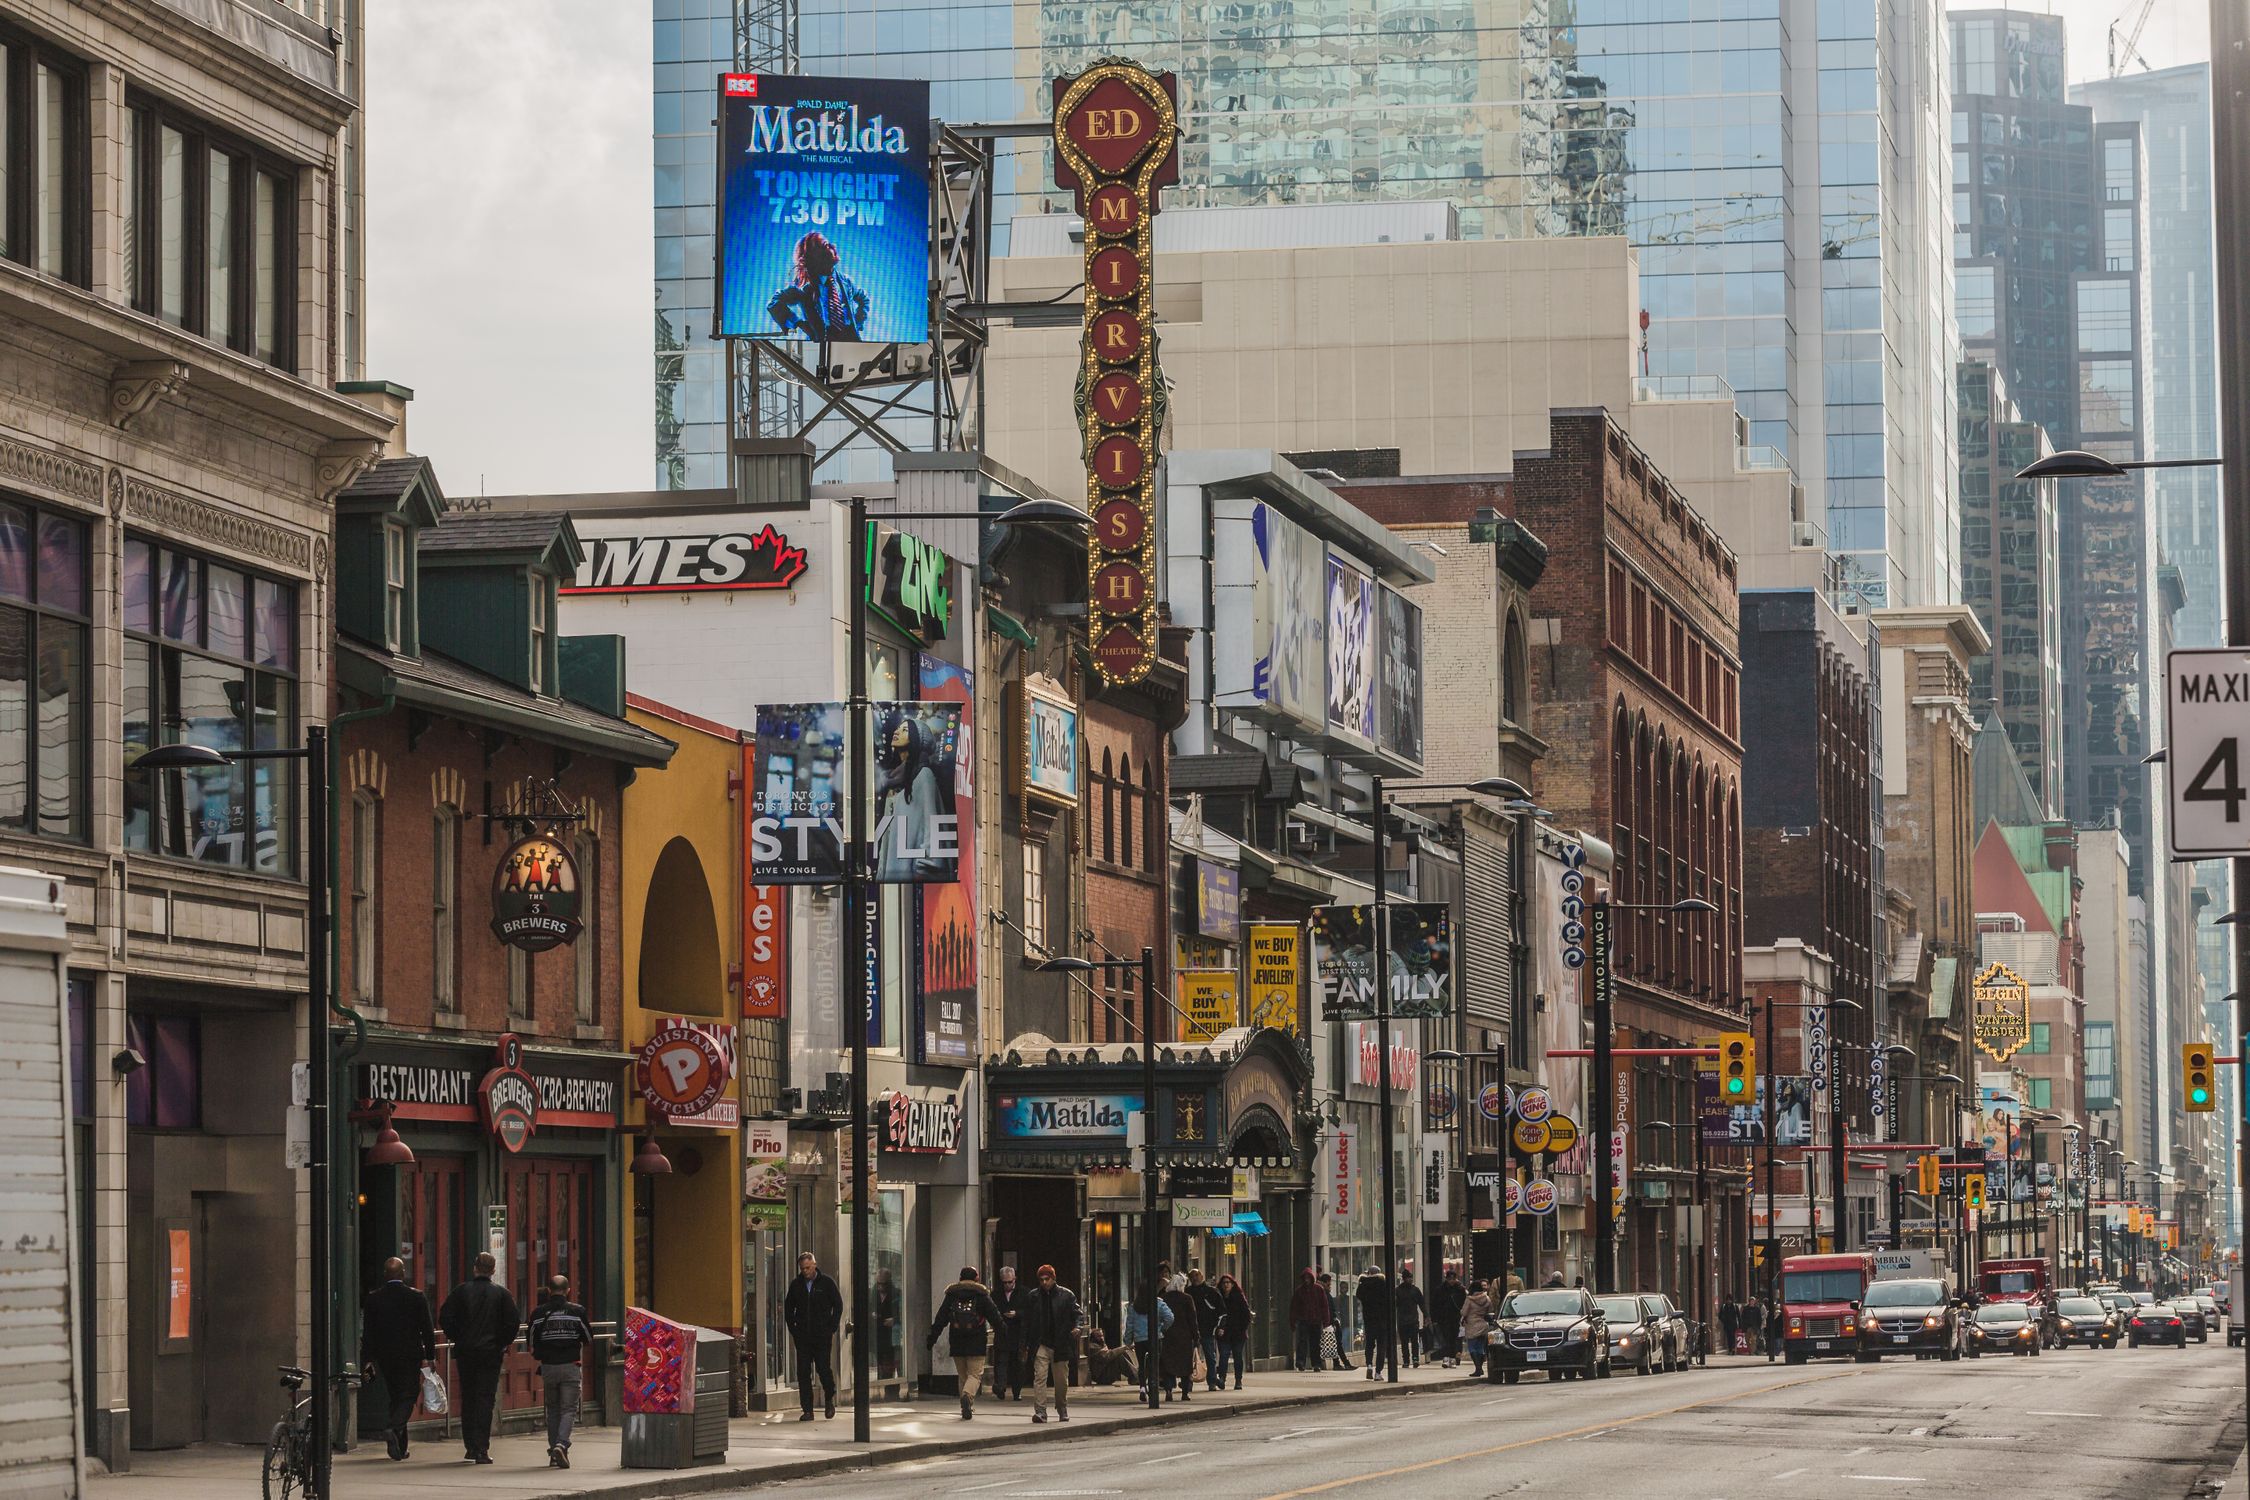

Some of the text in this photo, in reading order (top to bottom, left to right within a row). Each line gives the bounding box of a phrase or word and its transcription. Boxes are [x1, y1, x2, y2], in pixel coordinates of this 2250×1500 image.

[727, 78, 755, 93] RSC
[797, 99, 822, 109] ROALD
[745, 104, 909, 154] Matilda
[1086, 108, 1142, 141] ED
[802, 154, 854, 164] THE MUSICAL
[754, 170, 899, 200] TONIGHT
[769, 198, 885, 226] 7.30 PM
[1100, 647, 1143, 658] THEATRE
[2181, 673, 2248, 703] MAXI
[1035, 713, 1071, 775] Matilda
[2183, 737, 2247, 822] 4
[757, 791, 828, 800] TORONTO'S
[757, 802, 836, 812] DISTRICT OF
[783, 866, 817, 874] YONGE
[531, 903, 541, 914] 3
[1562, 845, 1586, 969] Yonge
[502, 917, 568, 934] BREWERS
[1254, 937, 1295, 953] WE BUY
[1258, 954, 1290, 966] YOUR
[1595, 911, 1605, 1001] DOWNTOWN
[747, 975, 776, 989] LOUISIANA
[1253, 969, 1295, 985] JEWELLERY
[755, 982, 769, 998] P
[1197, 986, 1213, 995] WE
[1974, 986, 2023, 1000] ELGIN
[748, 995, 775, 1007] KITCHEN
[1192, 997, 1217, 1009] BUY
[1190, 1011, 1221, 1019] YOUR
[1974, 1015, 2023, 1024] WINTER
[1188, 1021, 1233, 1035] JEWELLERY
[1974, 1026, 2024, 1037] GARDEN
[508, 1042, 516, 1066] 3
[641, 1030, 719, 1066] LOUISIANA
[1810, 1007, 1826, 1091] Yonge
[1360, 1023, 1417, 1091] Foo ocker
[661, 1048, 700, 1093] P
[370, 1064, 471, 1105] RESTAURANT
[1871, 1042, 1884, 1116] Yonge
[492, 1077, 533, 1116] BREWERS
[643, 1084, 717, 1114] KITCHEN
[1483, 1091, 1508, 1101] BURGR
[1521, 1096, 1546, 1105] BURGER
[1617, 1071, 1629, 1121] Payless
[1705, 1096, 1722, 1104] FOR
[1029, 1099, 1126, 1130] Matilda
[1522, 1101, 1547, 1115] KING
[1700, 1107, 1728, 1116] LEASE
[908, 1101, 956, 1149] GAMES
[1518, 1126, 1545, 1138] Money
[752, 1138, 782, 1153] Pho
[1520, 1133, 1544, 1144] Mart
[1336, 1131, 1349, 1215] Foot Locker
[1432, 1150, 1440, 1191] HOOPS
[1425, 1165, 1433, 1205] HOUSE
[1467, 1172, 1500, 1187] VANS
[1506, 1192, 1519, 1202] NG
[1527, 1186, 1552, 1197] BURGER
[1528, 1193, 1553, 1206] KING
[1190, 1206, 1225, 1217] Biovital
[1919, 1220, 1937, 1228] Suite
[1781, 1236, 1802, 1248] 221
